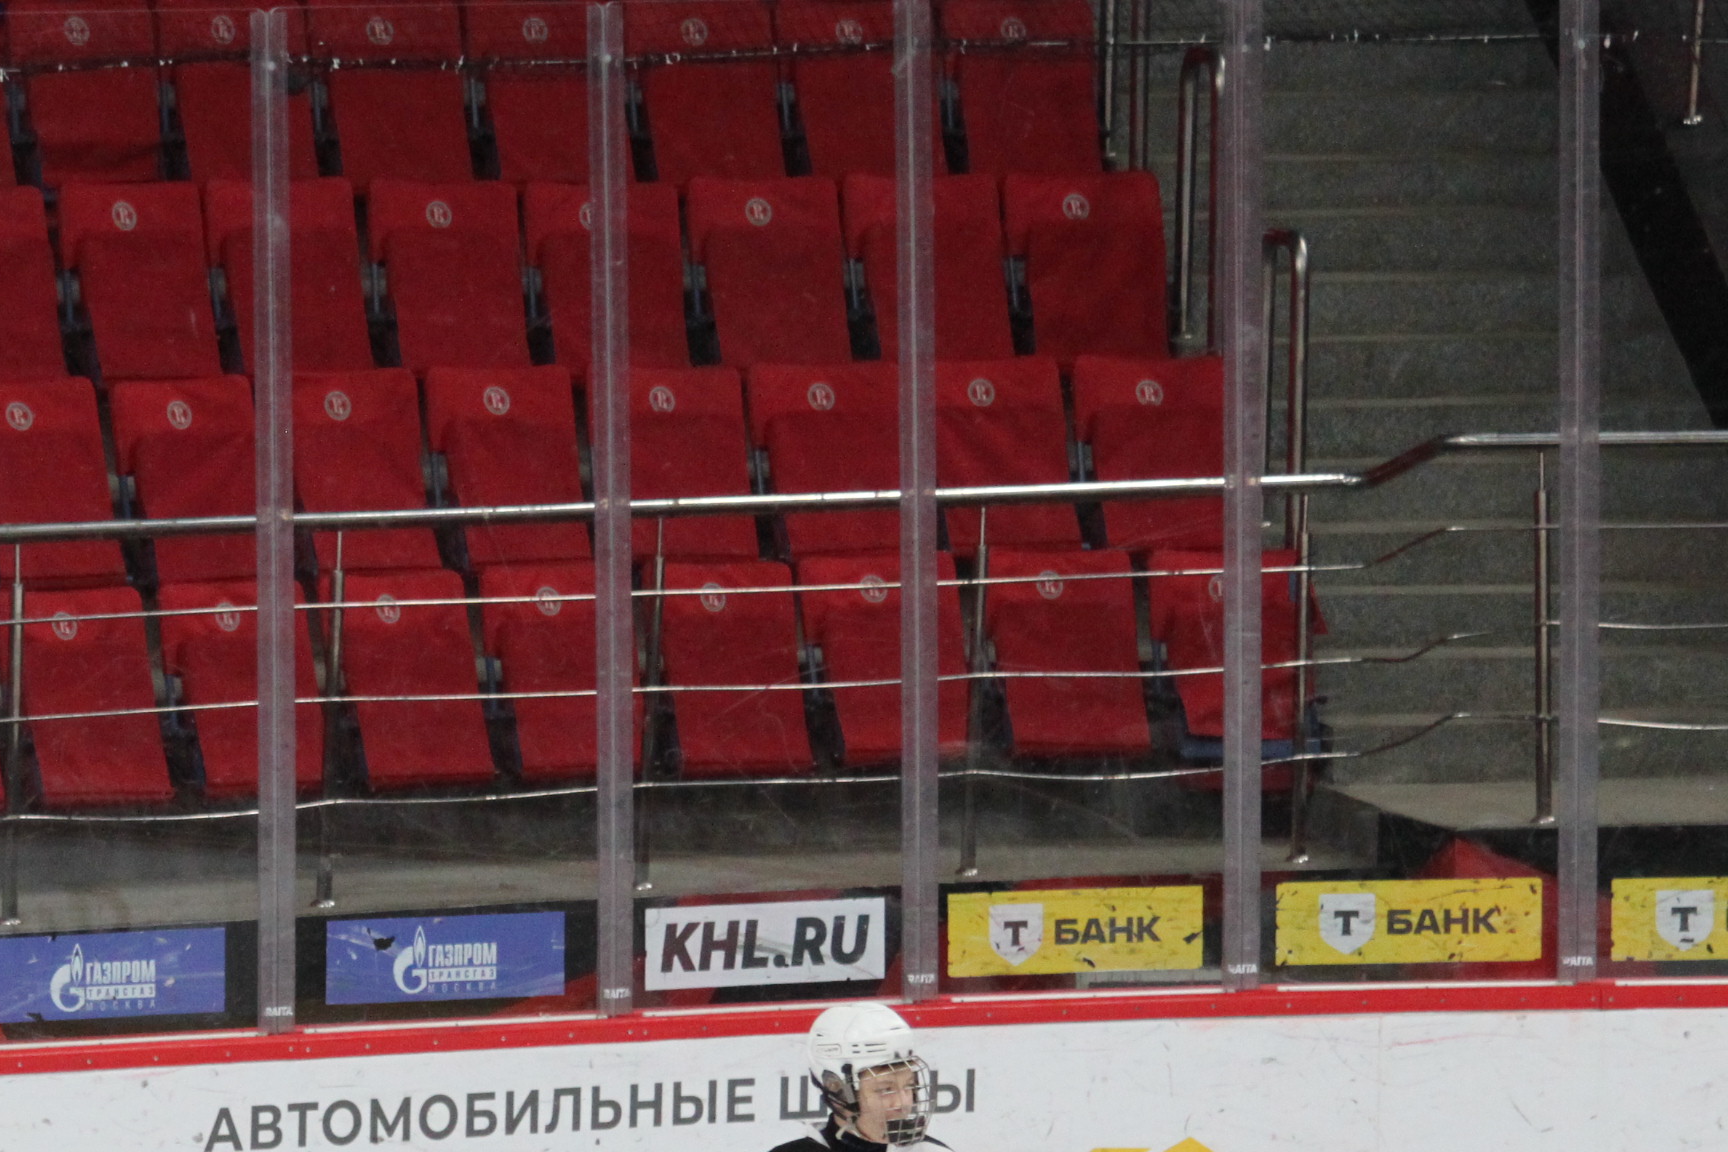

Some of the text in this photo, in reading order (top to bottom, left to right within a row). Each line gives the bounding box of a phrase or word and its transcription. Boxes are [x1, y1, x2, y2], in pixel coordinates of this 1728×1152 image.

[1054, 916, 1162, 945] БАНК
[1386, 908, 1499, 935] БАНК
[428, 942, 497, 967] ГАЗПРОМ
[661, 914, 870, 973] KHL.RU
[86, 960, 156, 985] ГАЗПРОМ
[430, 968, 496, 981] ТРАНСГАЗ
[87, 986, 155, 999] ТРАНСГАЗ
[427, 981, 496, 994] МОСКВА
[86, 999, 156, 1011] МОСКВА
[203, 1068, 974, 1152] АВТОМОБИЛЬНЫЕ ШЫ
